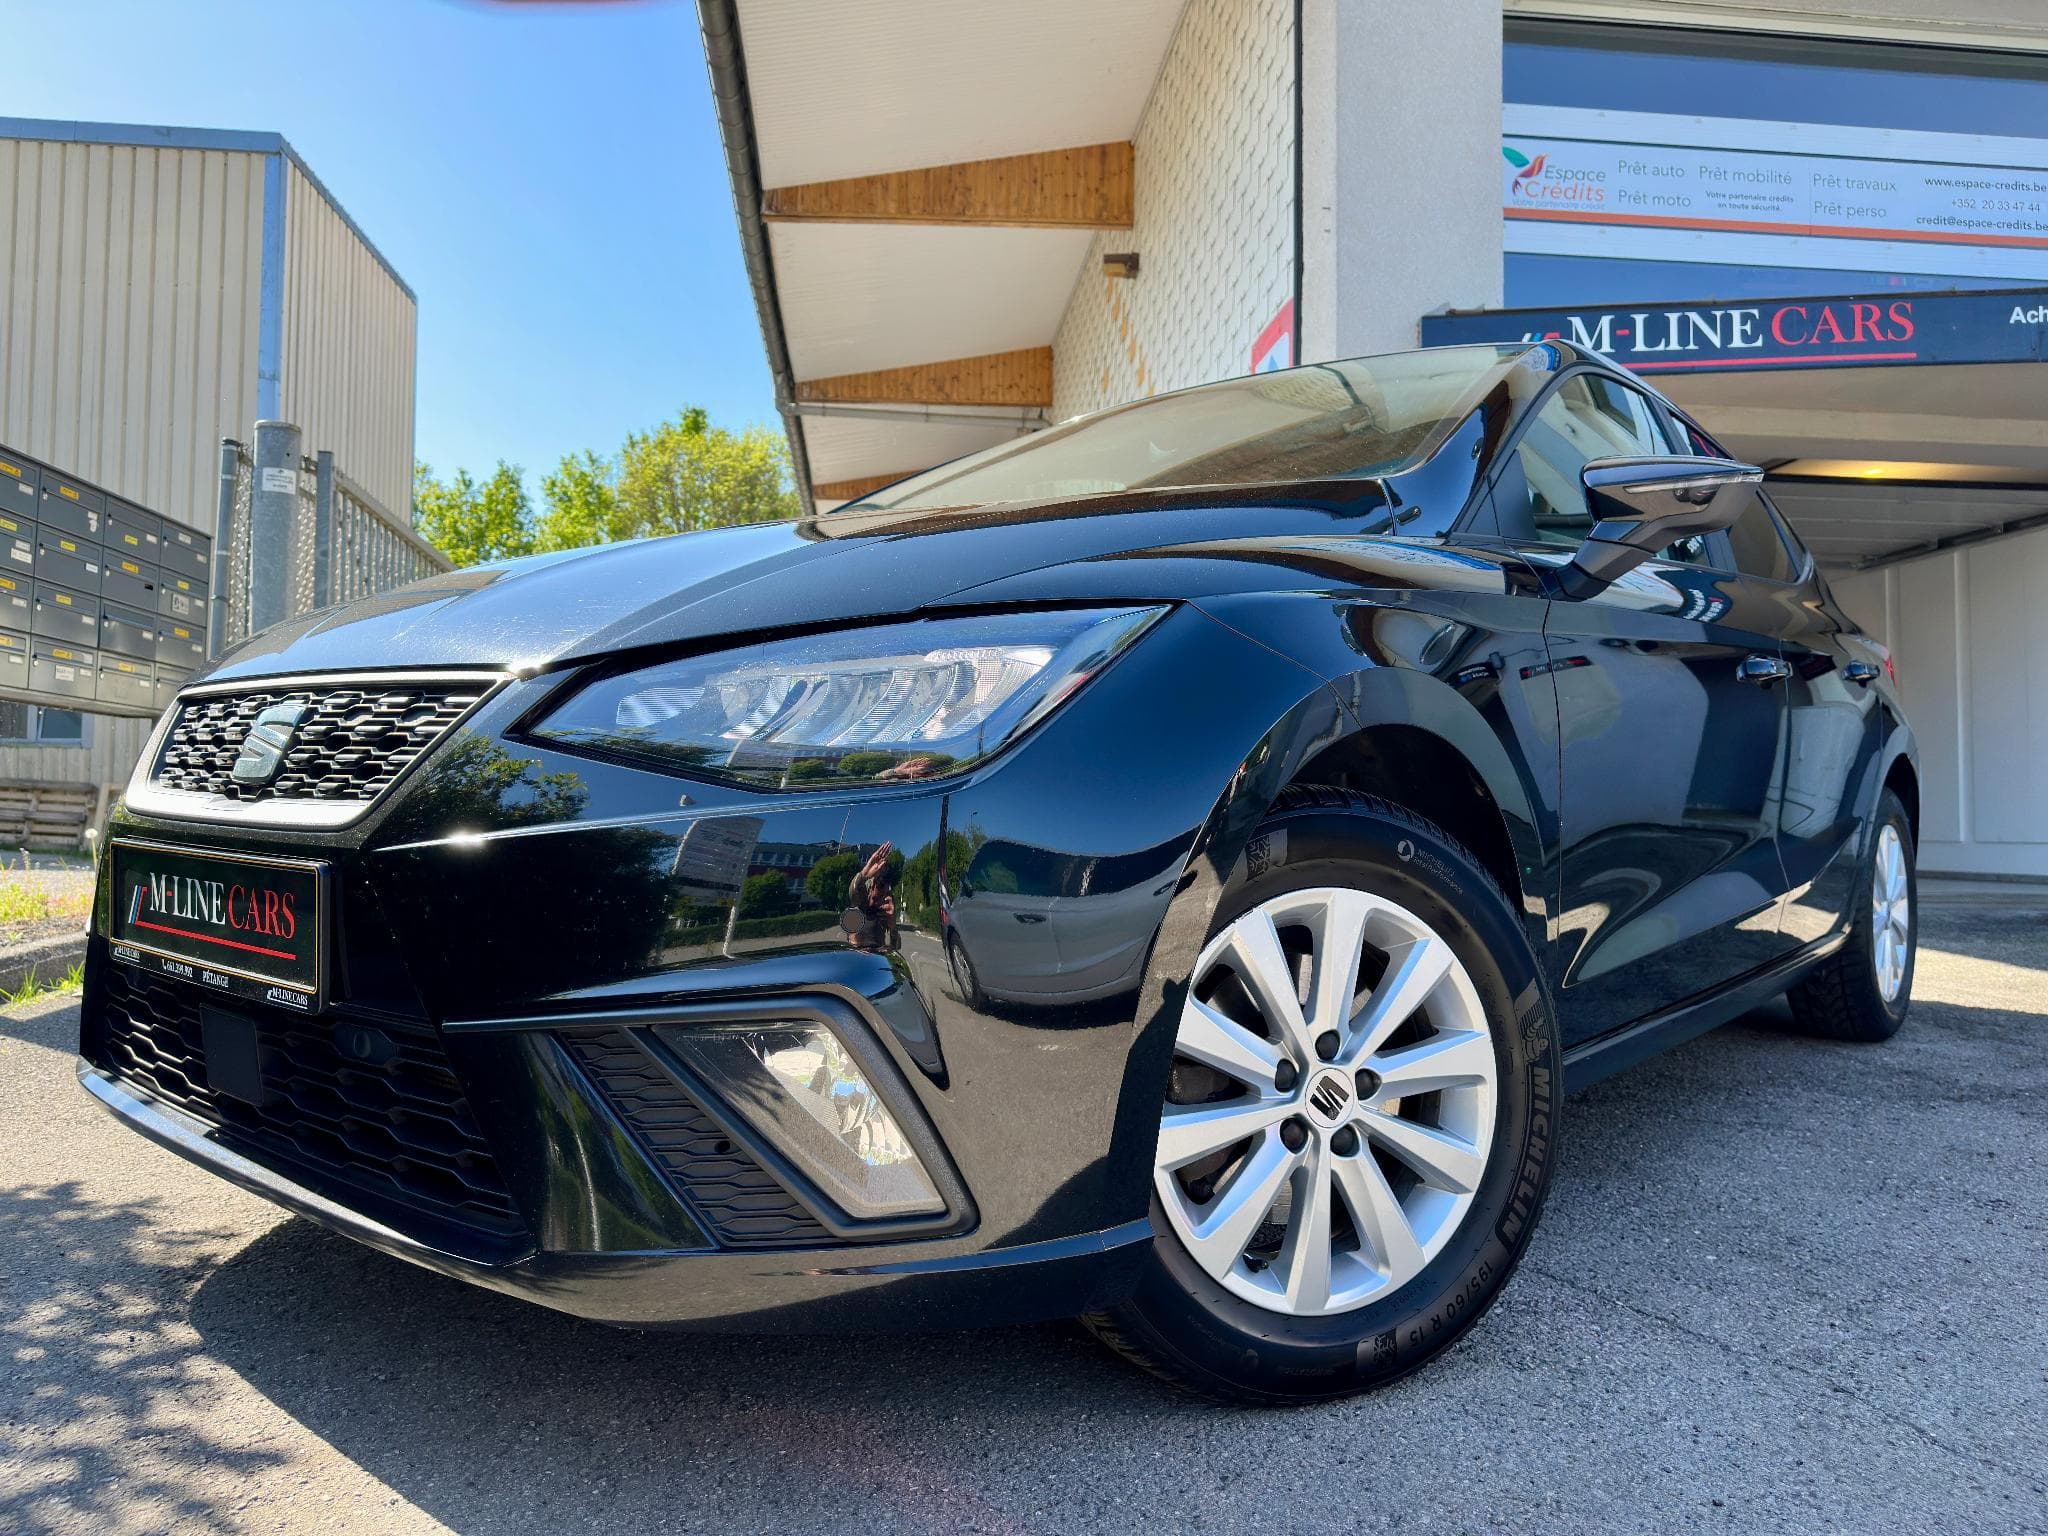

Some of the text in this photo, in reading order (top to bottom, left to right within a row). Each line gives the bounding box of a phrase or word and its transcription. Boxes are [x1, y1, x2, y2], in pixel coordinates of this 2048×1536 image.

[1545, 165, 1606, 183] Espace
[1618, 160, 1685, 178] Prêt auto
[1699, 166, 1793, 185] Prêt mobilité
[1525, 180, 1604, 202] Crédits
[1813, 172, 1896, 192] Prêt travaux
[1924, 176, 2047, 193] www.espace-credits.be
[1618, 189, 1691, 208] Prêt moto
[1706, 190, 1794, 203] Votre partenaire crédits
[1728, 201, 1748, 211] toute
[1952, 199, 2041, 213] +352 20 33 47 44
[1814, 200, 1887, 219] Prêt perso
[1916, 215, 2048, 232] credit@espace-credits.be
[1567, 302, 1914, 354] M-LINE CARS
[149, 870, 296, 940] M-LINE CARS
[1501, 1066, 1553, 1242] MICHELIN
[1445, 1260, 1494, 1319] 195/60
[1431, 1318, 1442, 1331] R
[1409, 1327, 1425, 1347] 15
